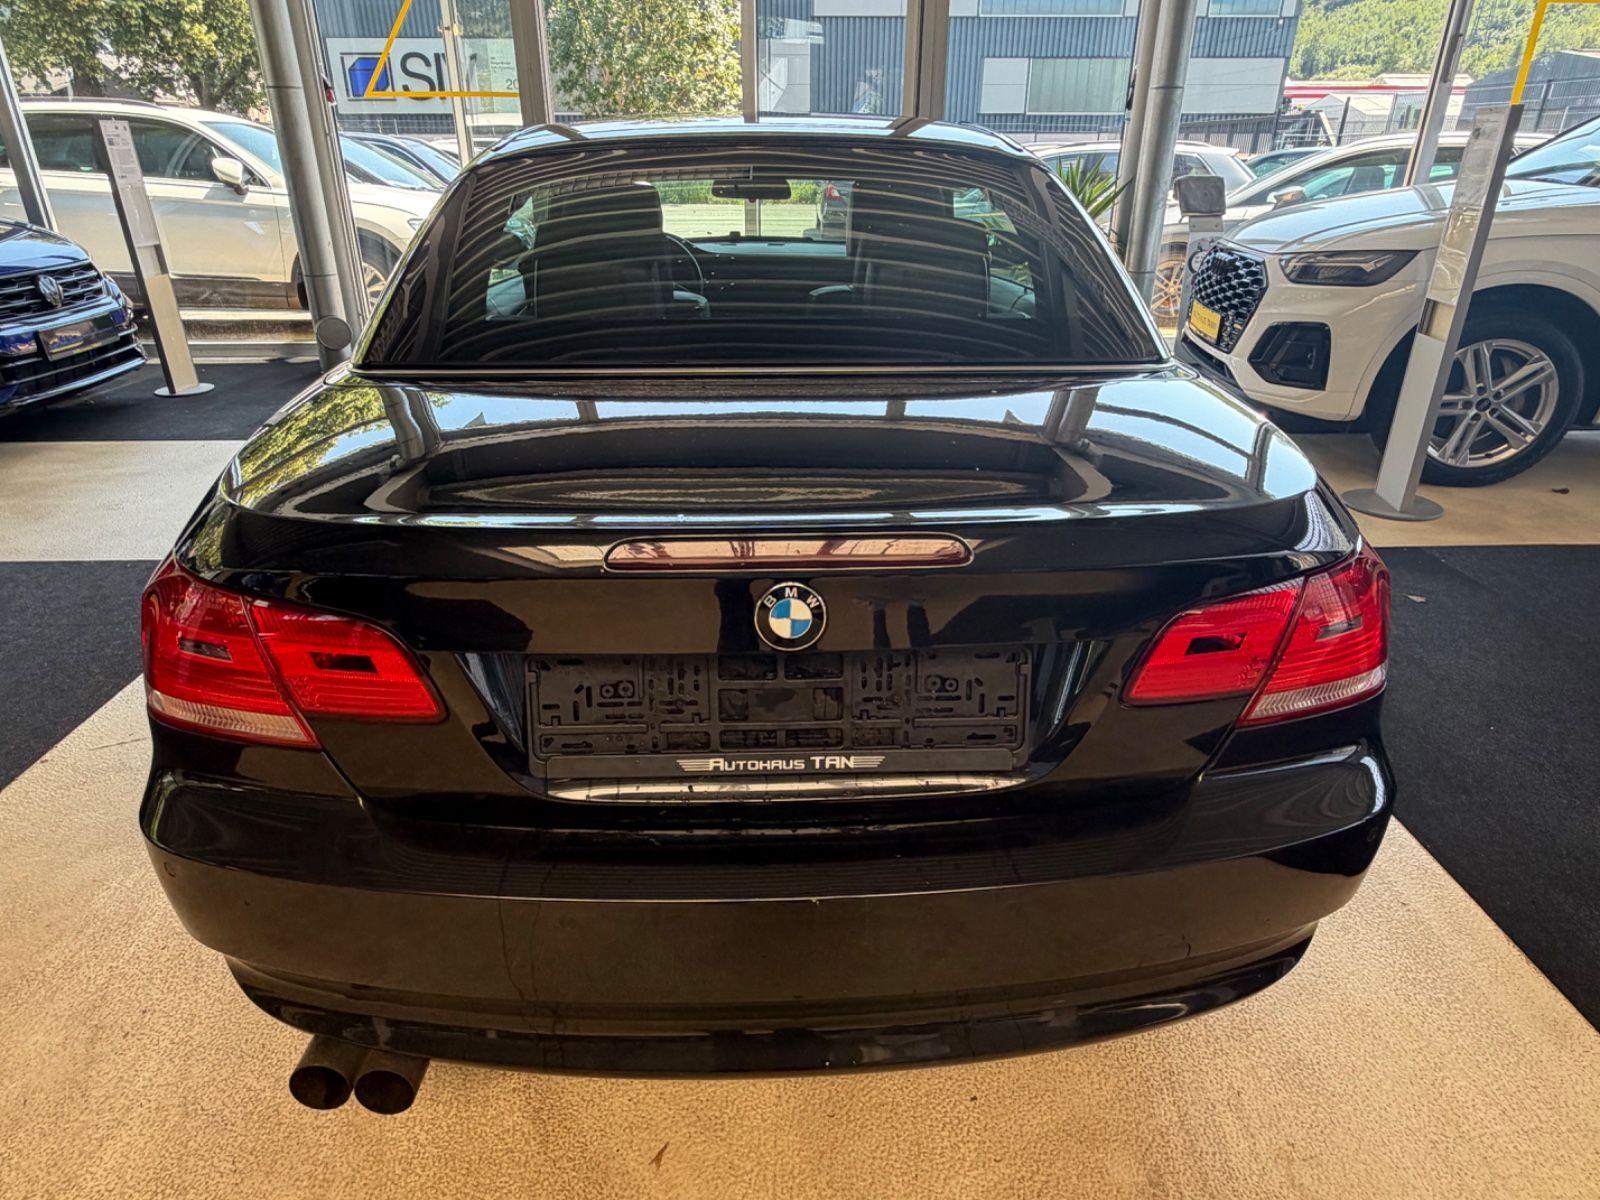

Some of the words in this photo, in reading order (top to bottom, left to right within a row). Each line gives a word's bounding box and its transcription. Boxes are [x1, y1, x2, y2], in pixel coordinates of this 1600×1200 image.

[763, 586, 820, 609] BMW
[709, 758, 805, 771] AUTOHAUS
[810, 756, 854, 769] TAN
